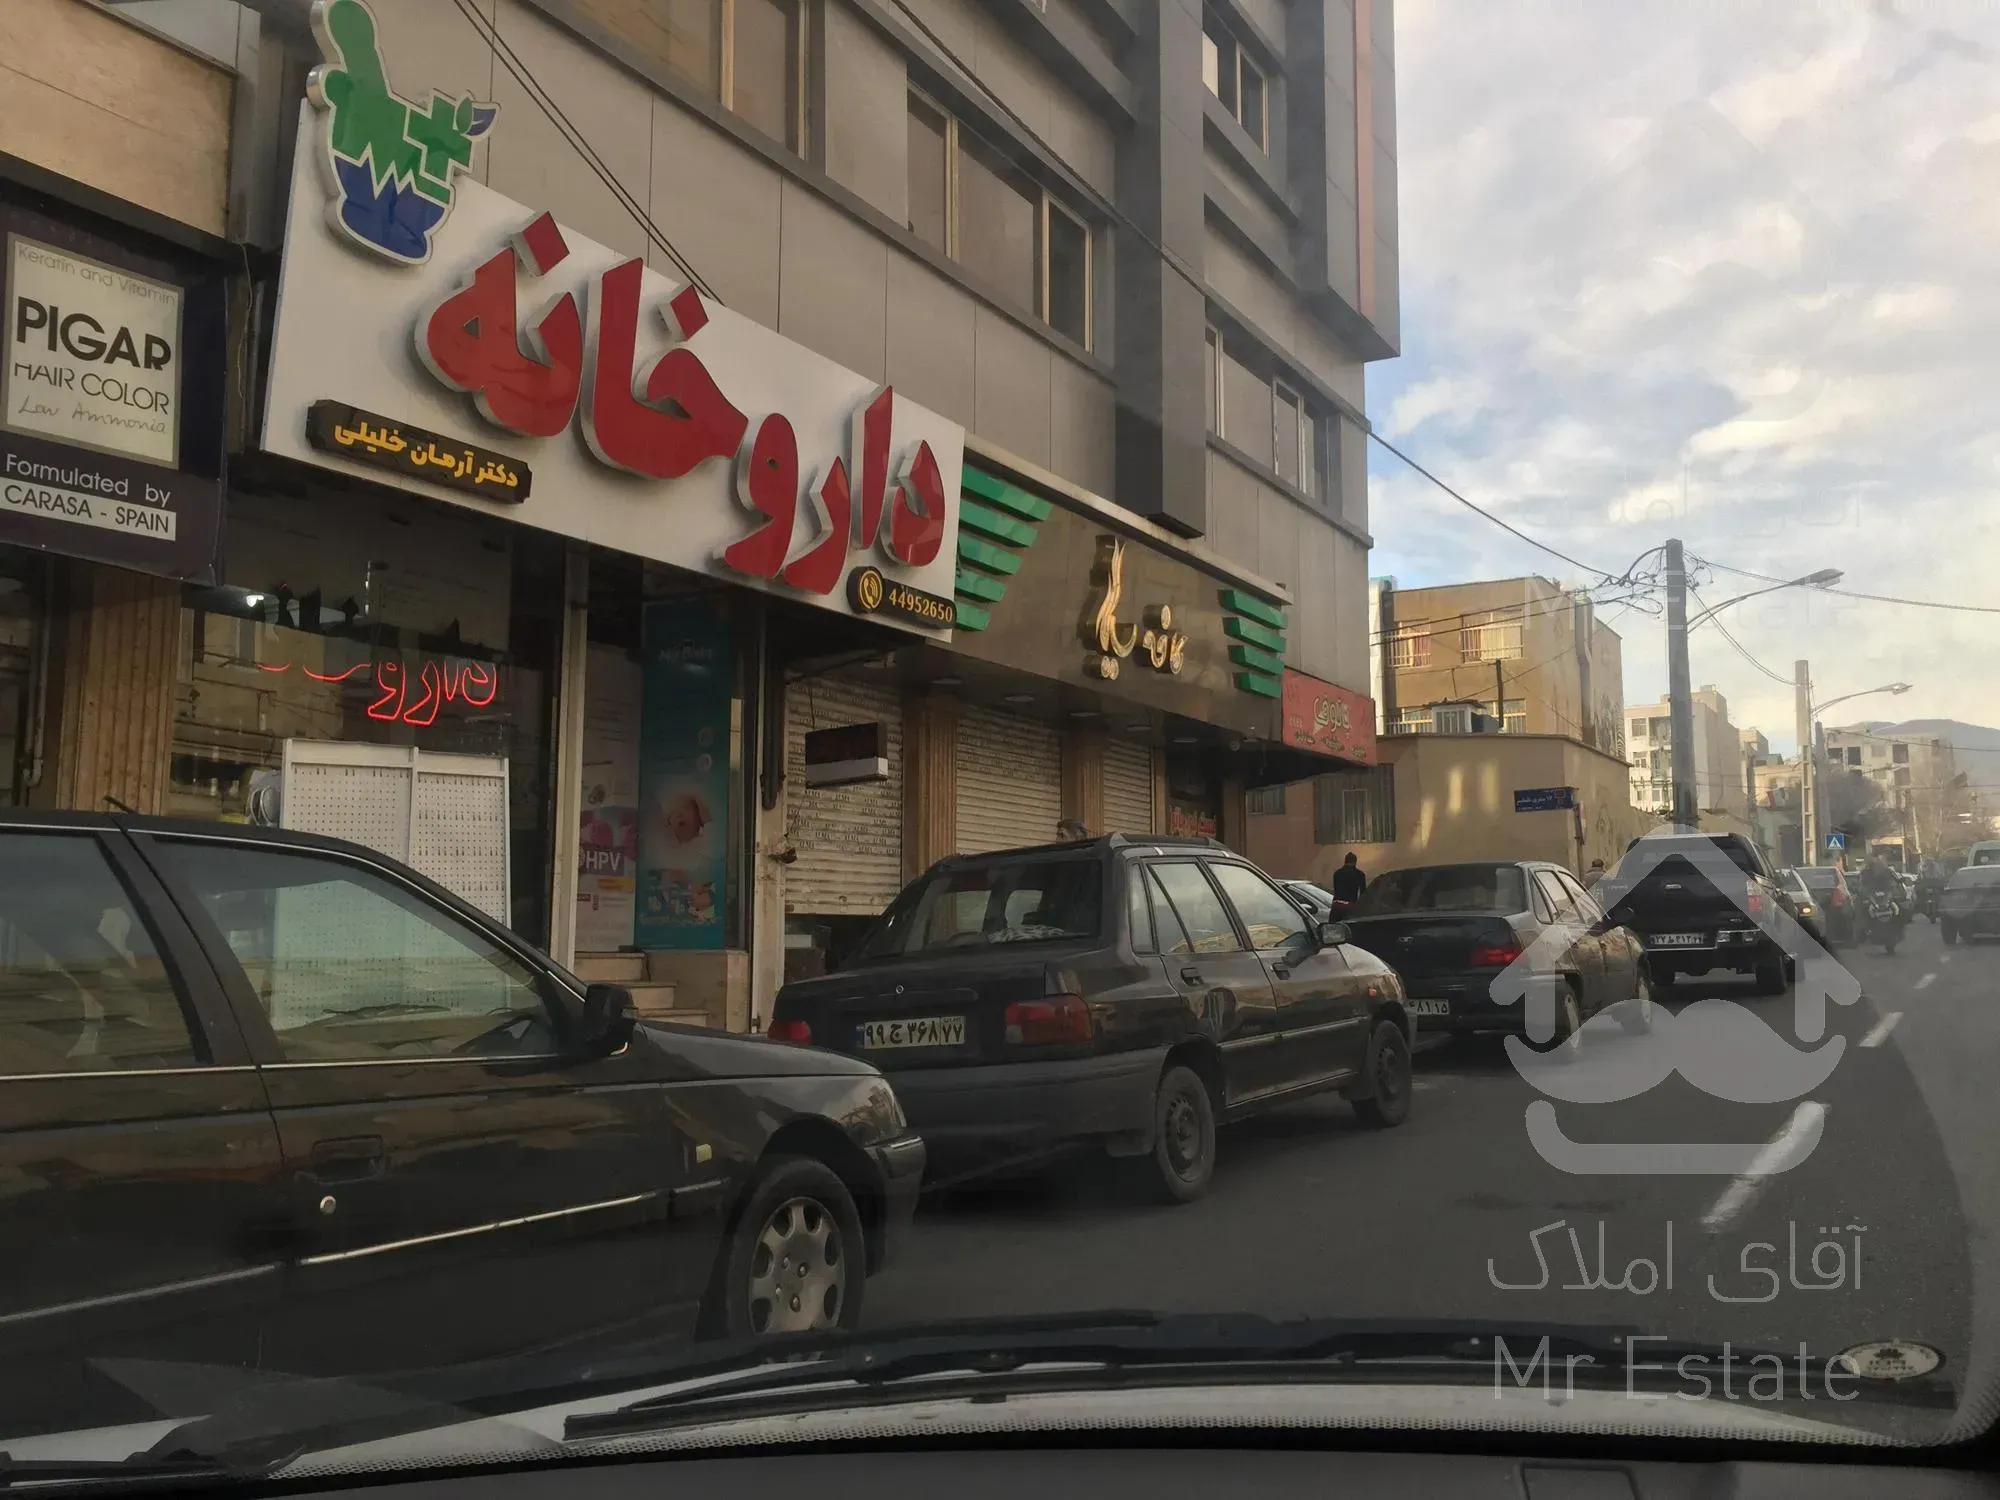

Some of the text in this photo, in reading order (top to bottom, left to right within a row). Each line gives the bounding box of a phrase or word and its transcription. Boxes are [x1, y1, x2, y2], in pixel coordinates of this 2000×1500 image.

[18, 243, 178, 308] Keratin and Vitamin
[16, 296, 172, 371] PIGAR
[14, 362, 170, 416] HAIR COLOR
[425, 210, 946, 596] داروخانه
[72, 401, 168, 434] Ammonia
[6, 453, 172, 508] Formulated by
[334, 422, 519, 487] دکتر آرمان خلیلی
[4, 483, 93, 519] CARASA
[115, 507, 170, 535] SPAIN
[888, 588, 953, 623] 44952650
[586, 850, 620, 873] HPV
